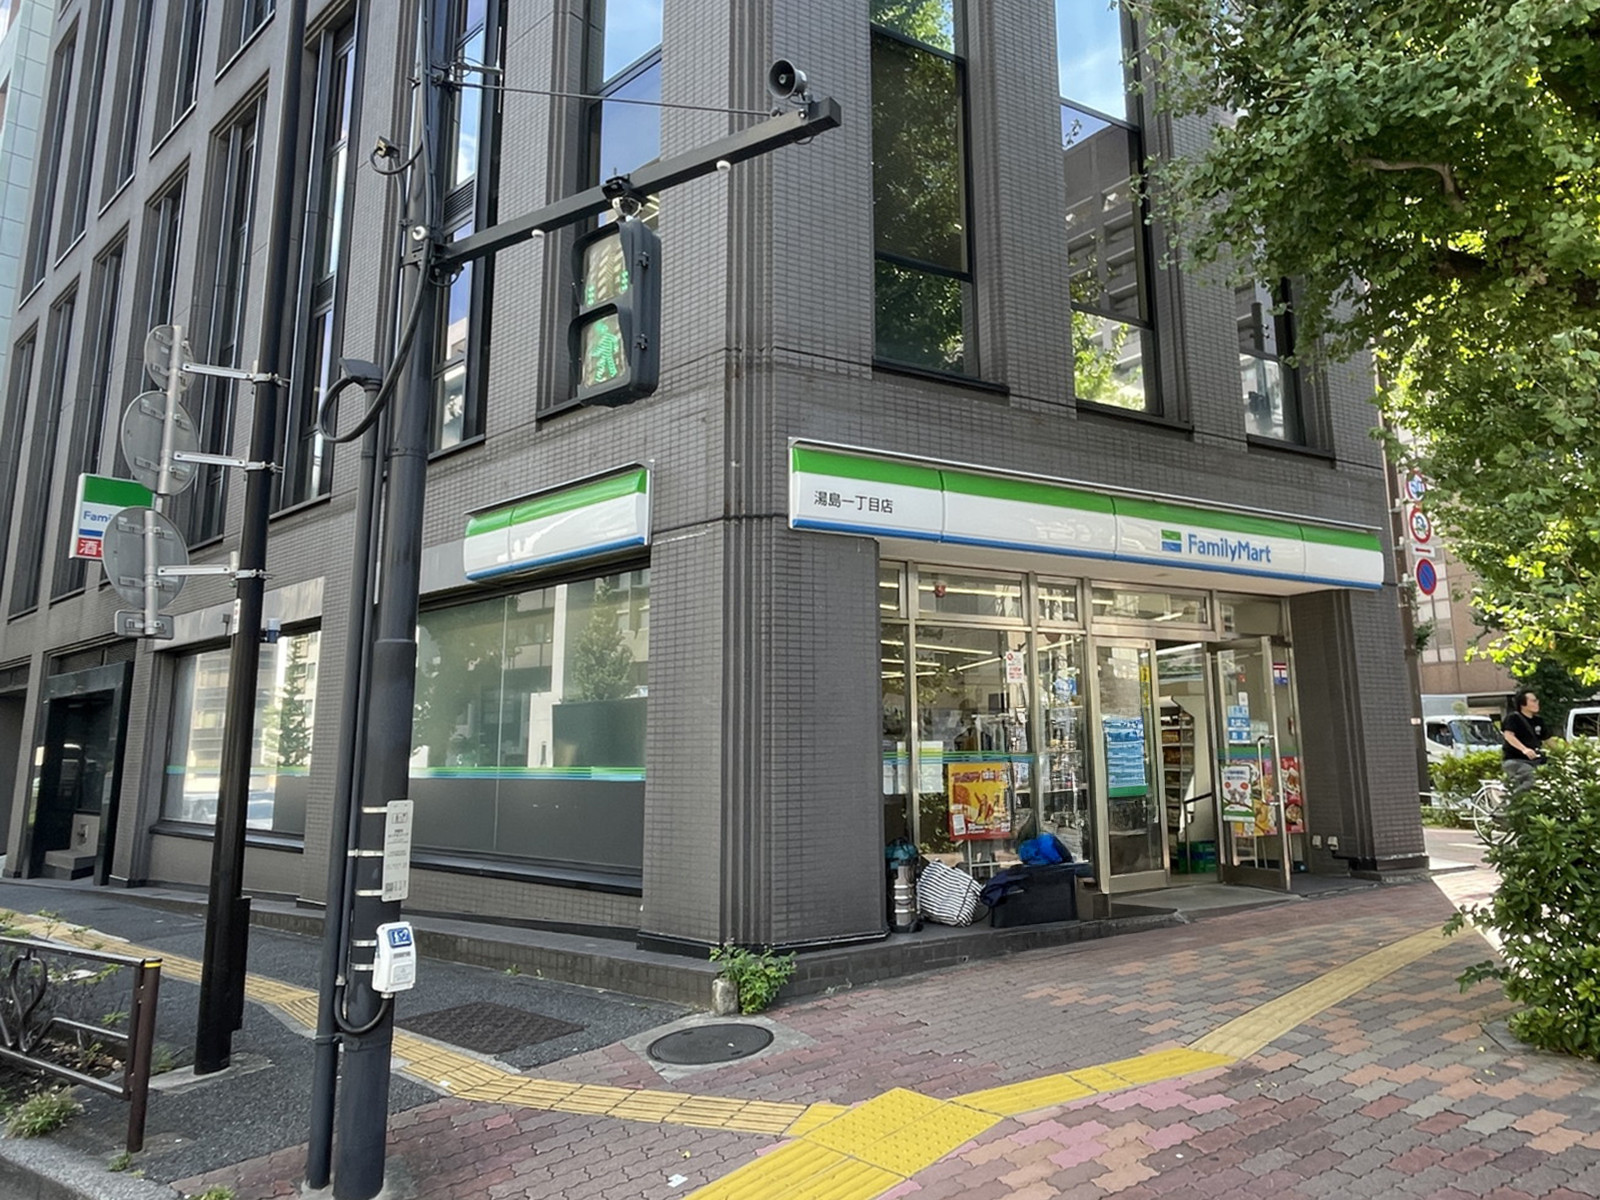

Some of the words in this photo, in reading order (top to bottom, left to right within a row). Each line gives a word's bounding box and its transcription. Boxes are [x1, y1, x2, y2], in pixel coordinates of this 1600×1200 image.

[814, 490, 893, 514] 湯島一丁目店
[1187, 533, 1272, 563] FamilyMart
